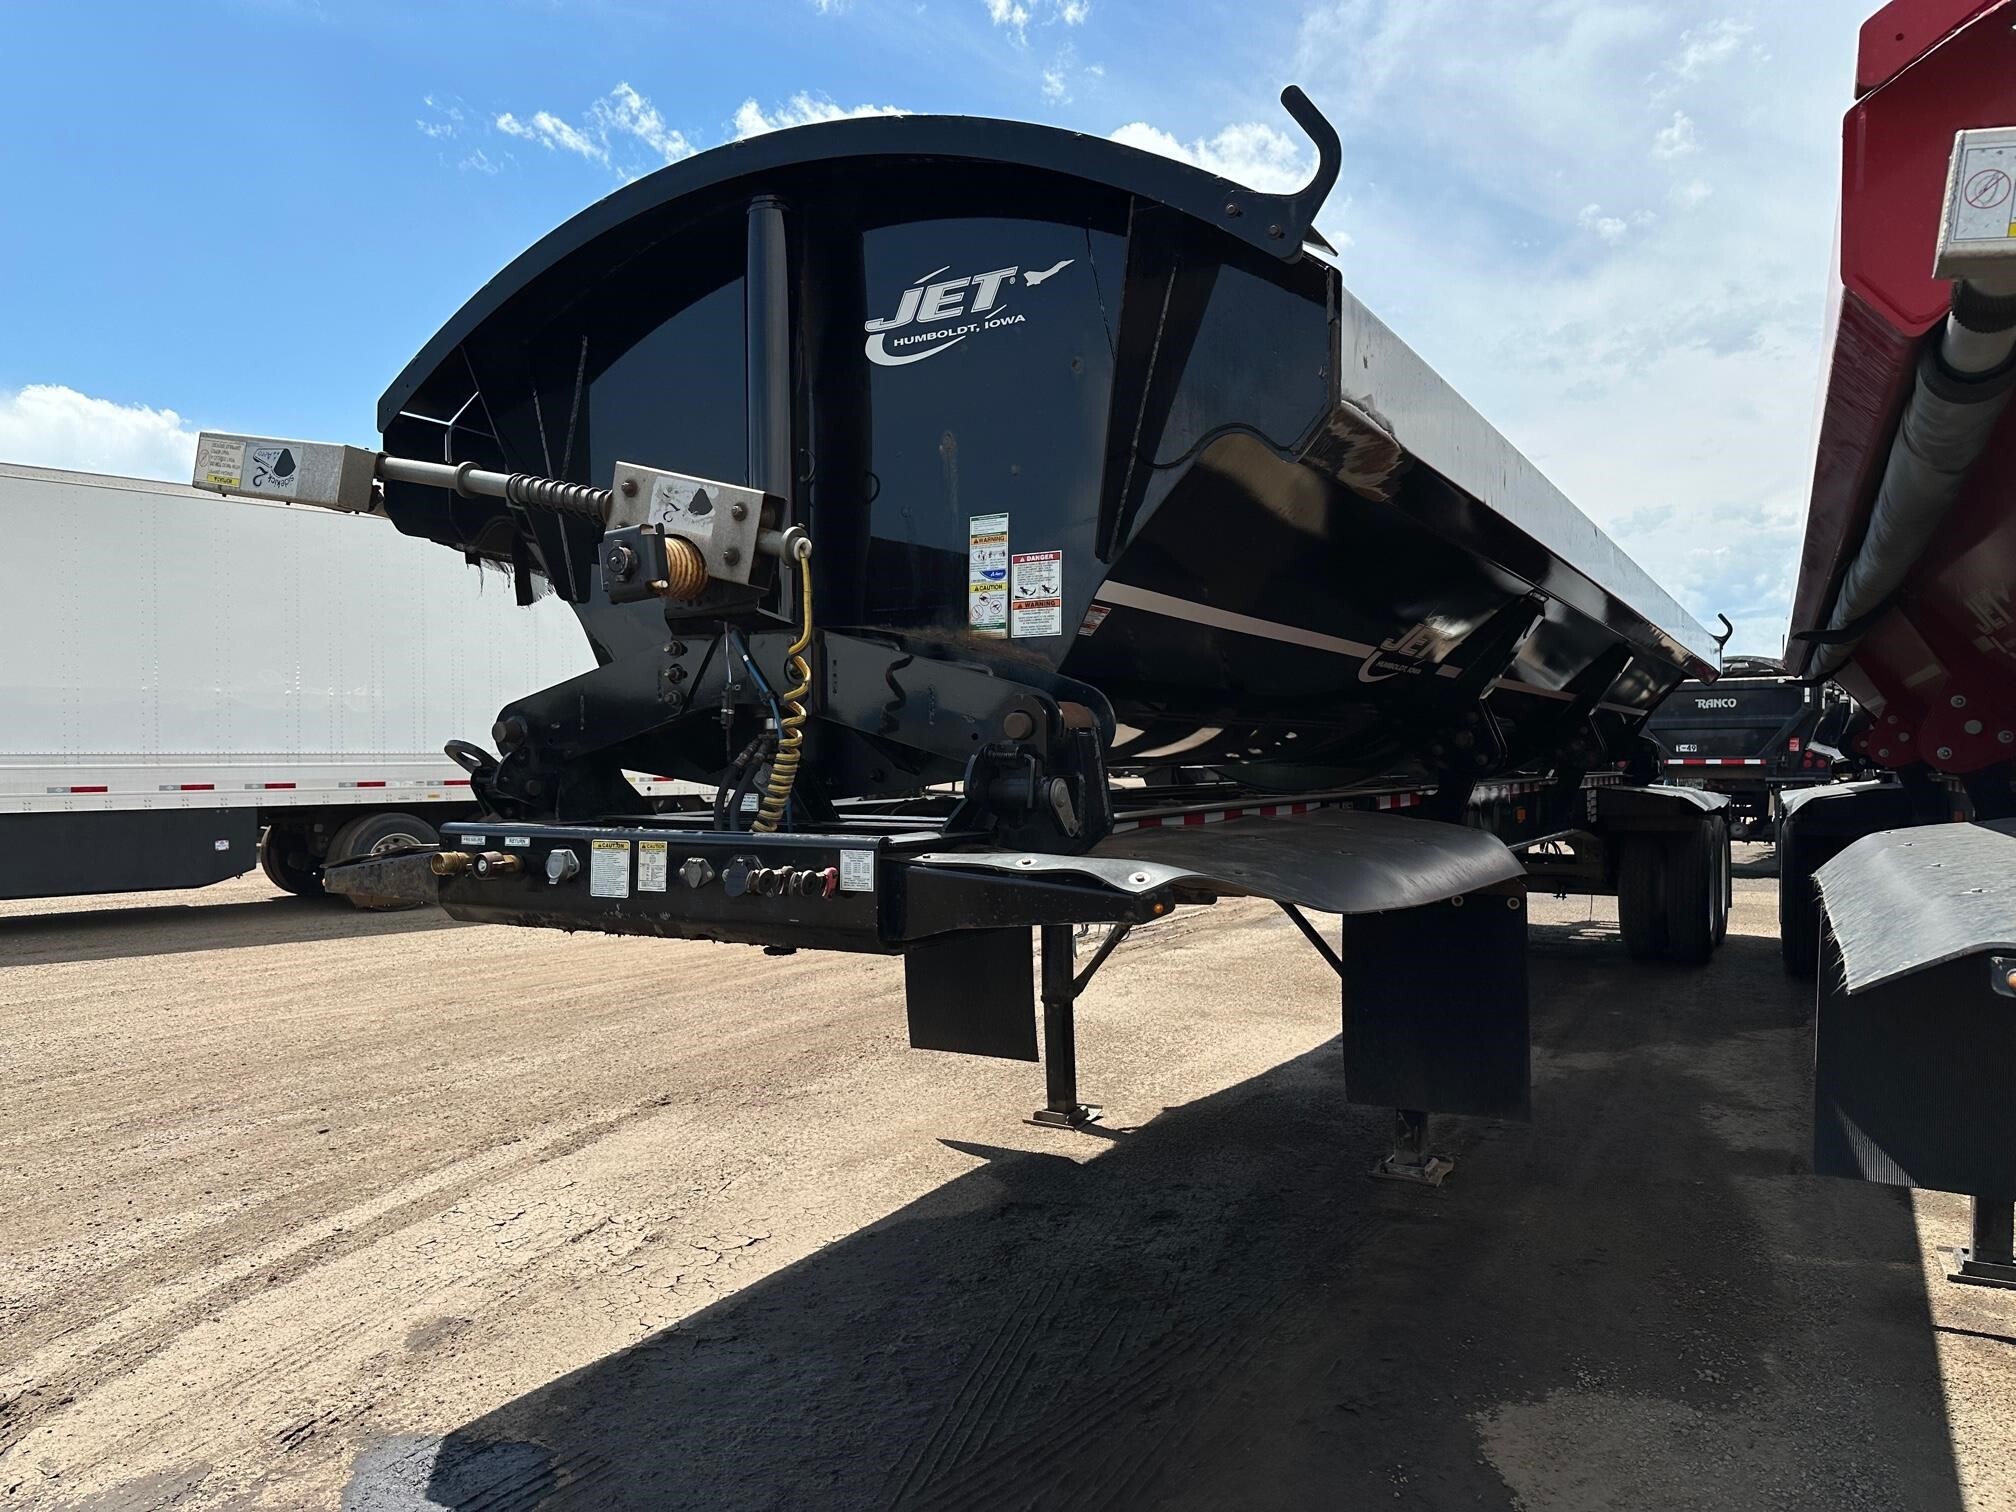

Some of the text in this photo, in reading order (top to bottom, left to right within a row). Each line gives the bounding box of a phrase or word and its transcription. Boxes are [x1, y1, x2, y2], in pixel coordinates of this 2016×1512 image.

[865, 266, 1019, 332] JET
[893, 313, 1026, 347] HUMBOLDT, IOWA
[978, 535, 1005, 543] WARNING
[1026, 553, 1054, 562] DANGER
[979, 584, 1003, 592] CAUTION
[1024, 600, 1056, 608] WARNING
[1695, 698, 1737, 709] RANCO
